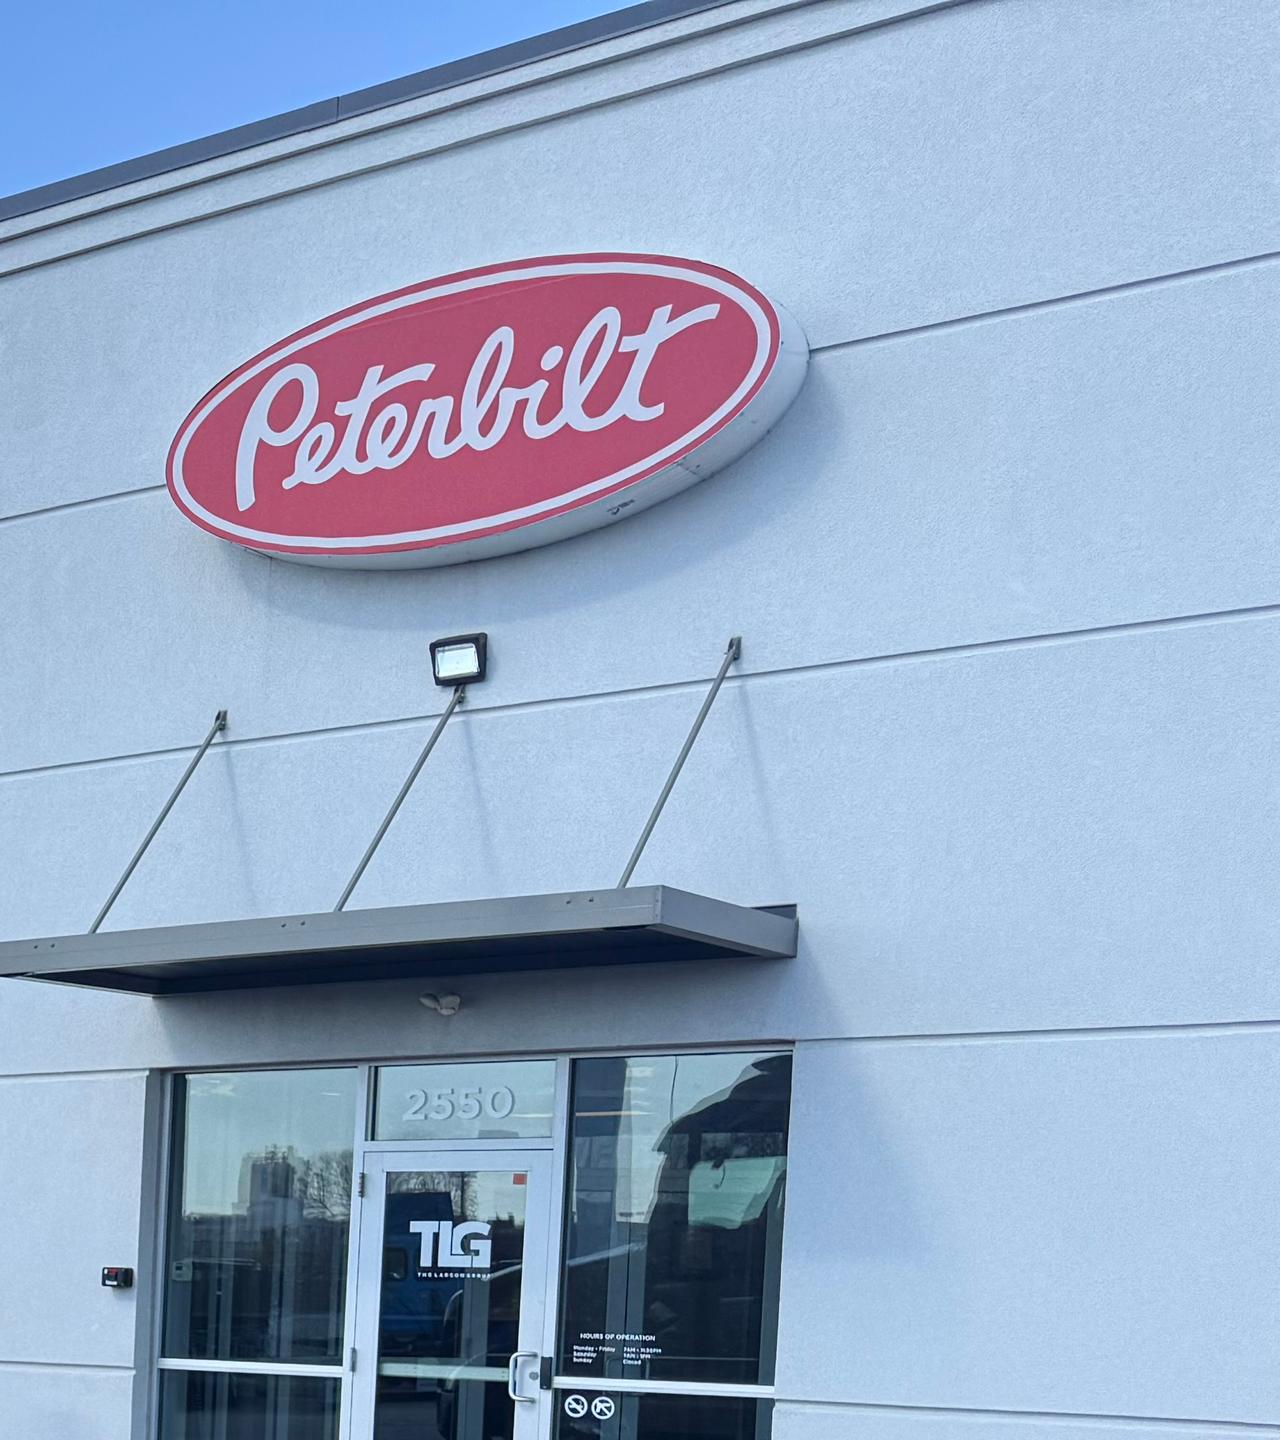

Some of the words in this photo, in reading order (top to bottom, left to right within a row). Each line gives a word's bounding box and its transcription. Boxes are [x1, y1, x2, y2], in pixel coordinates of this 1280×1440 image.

[236, 303, 720, 511] Peterbilt
[403, 1086, 516, 1121] 2550
[409, 1220, 492, 1268] TLG
[616, 1333, 656, 1342] OPERATION
